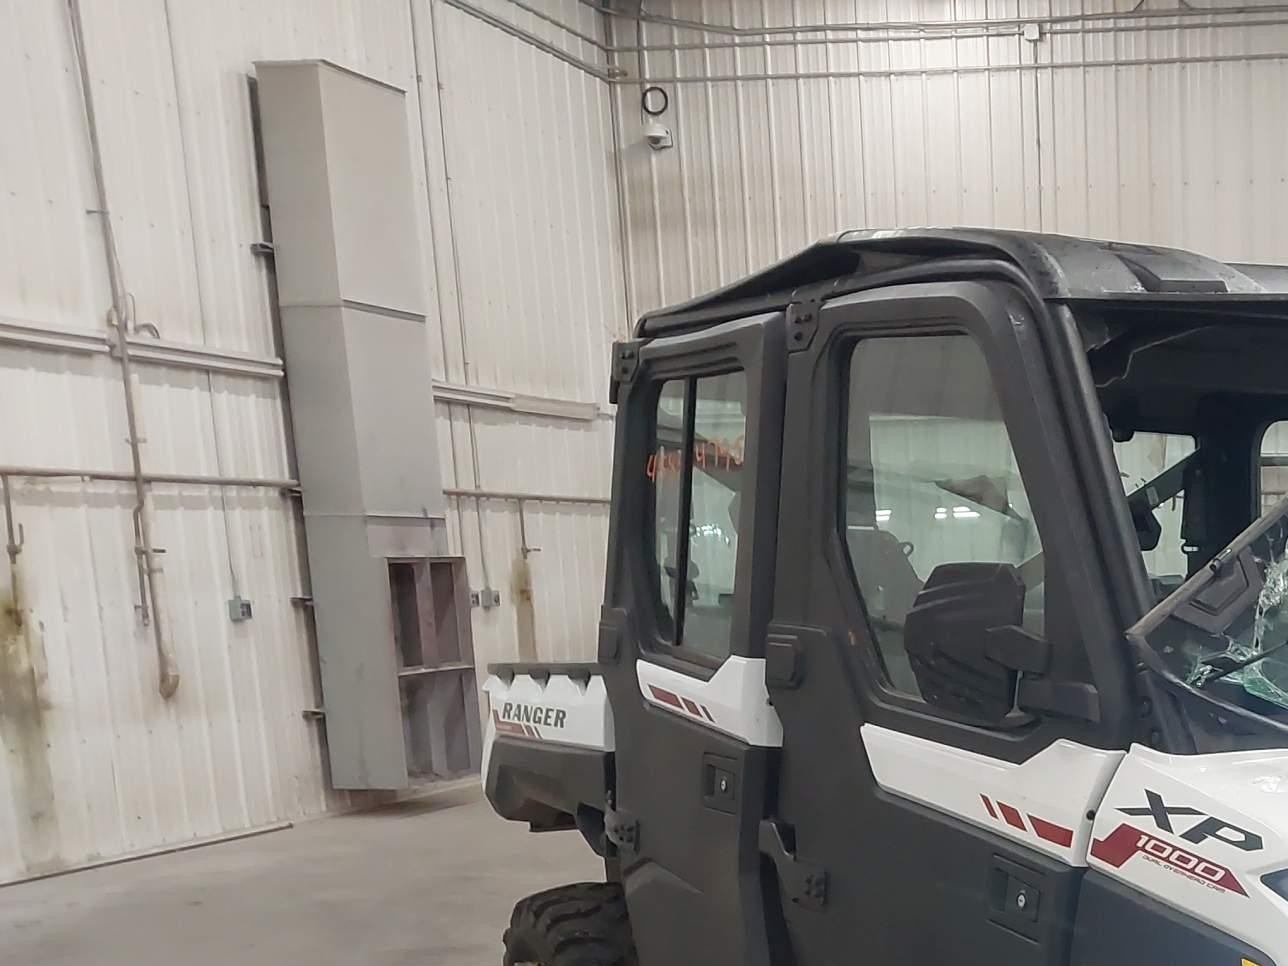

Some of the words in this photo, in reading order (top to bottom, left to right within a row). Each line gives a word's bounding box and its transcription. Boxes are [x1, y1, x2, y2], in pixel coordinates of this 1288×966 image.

[502, 702, 567, 729] RANGER
[1114, 788, 1264, 852] XP
[1135, 834, 1227, 882] 1000
